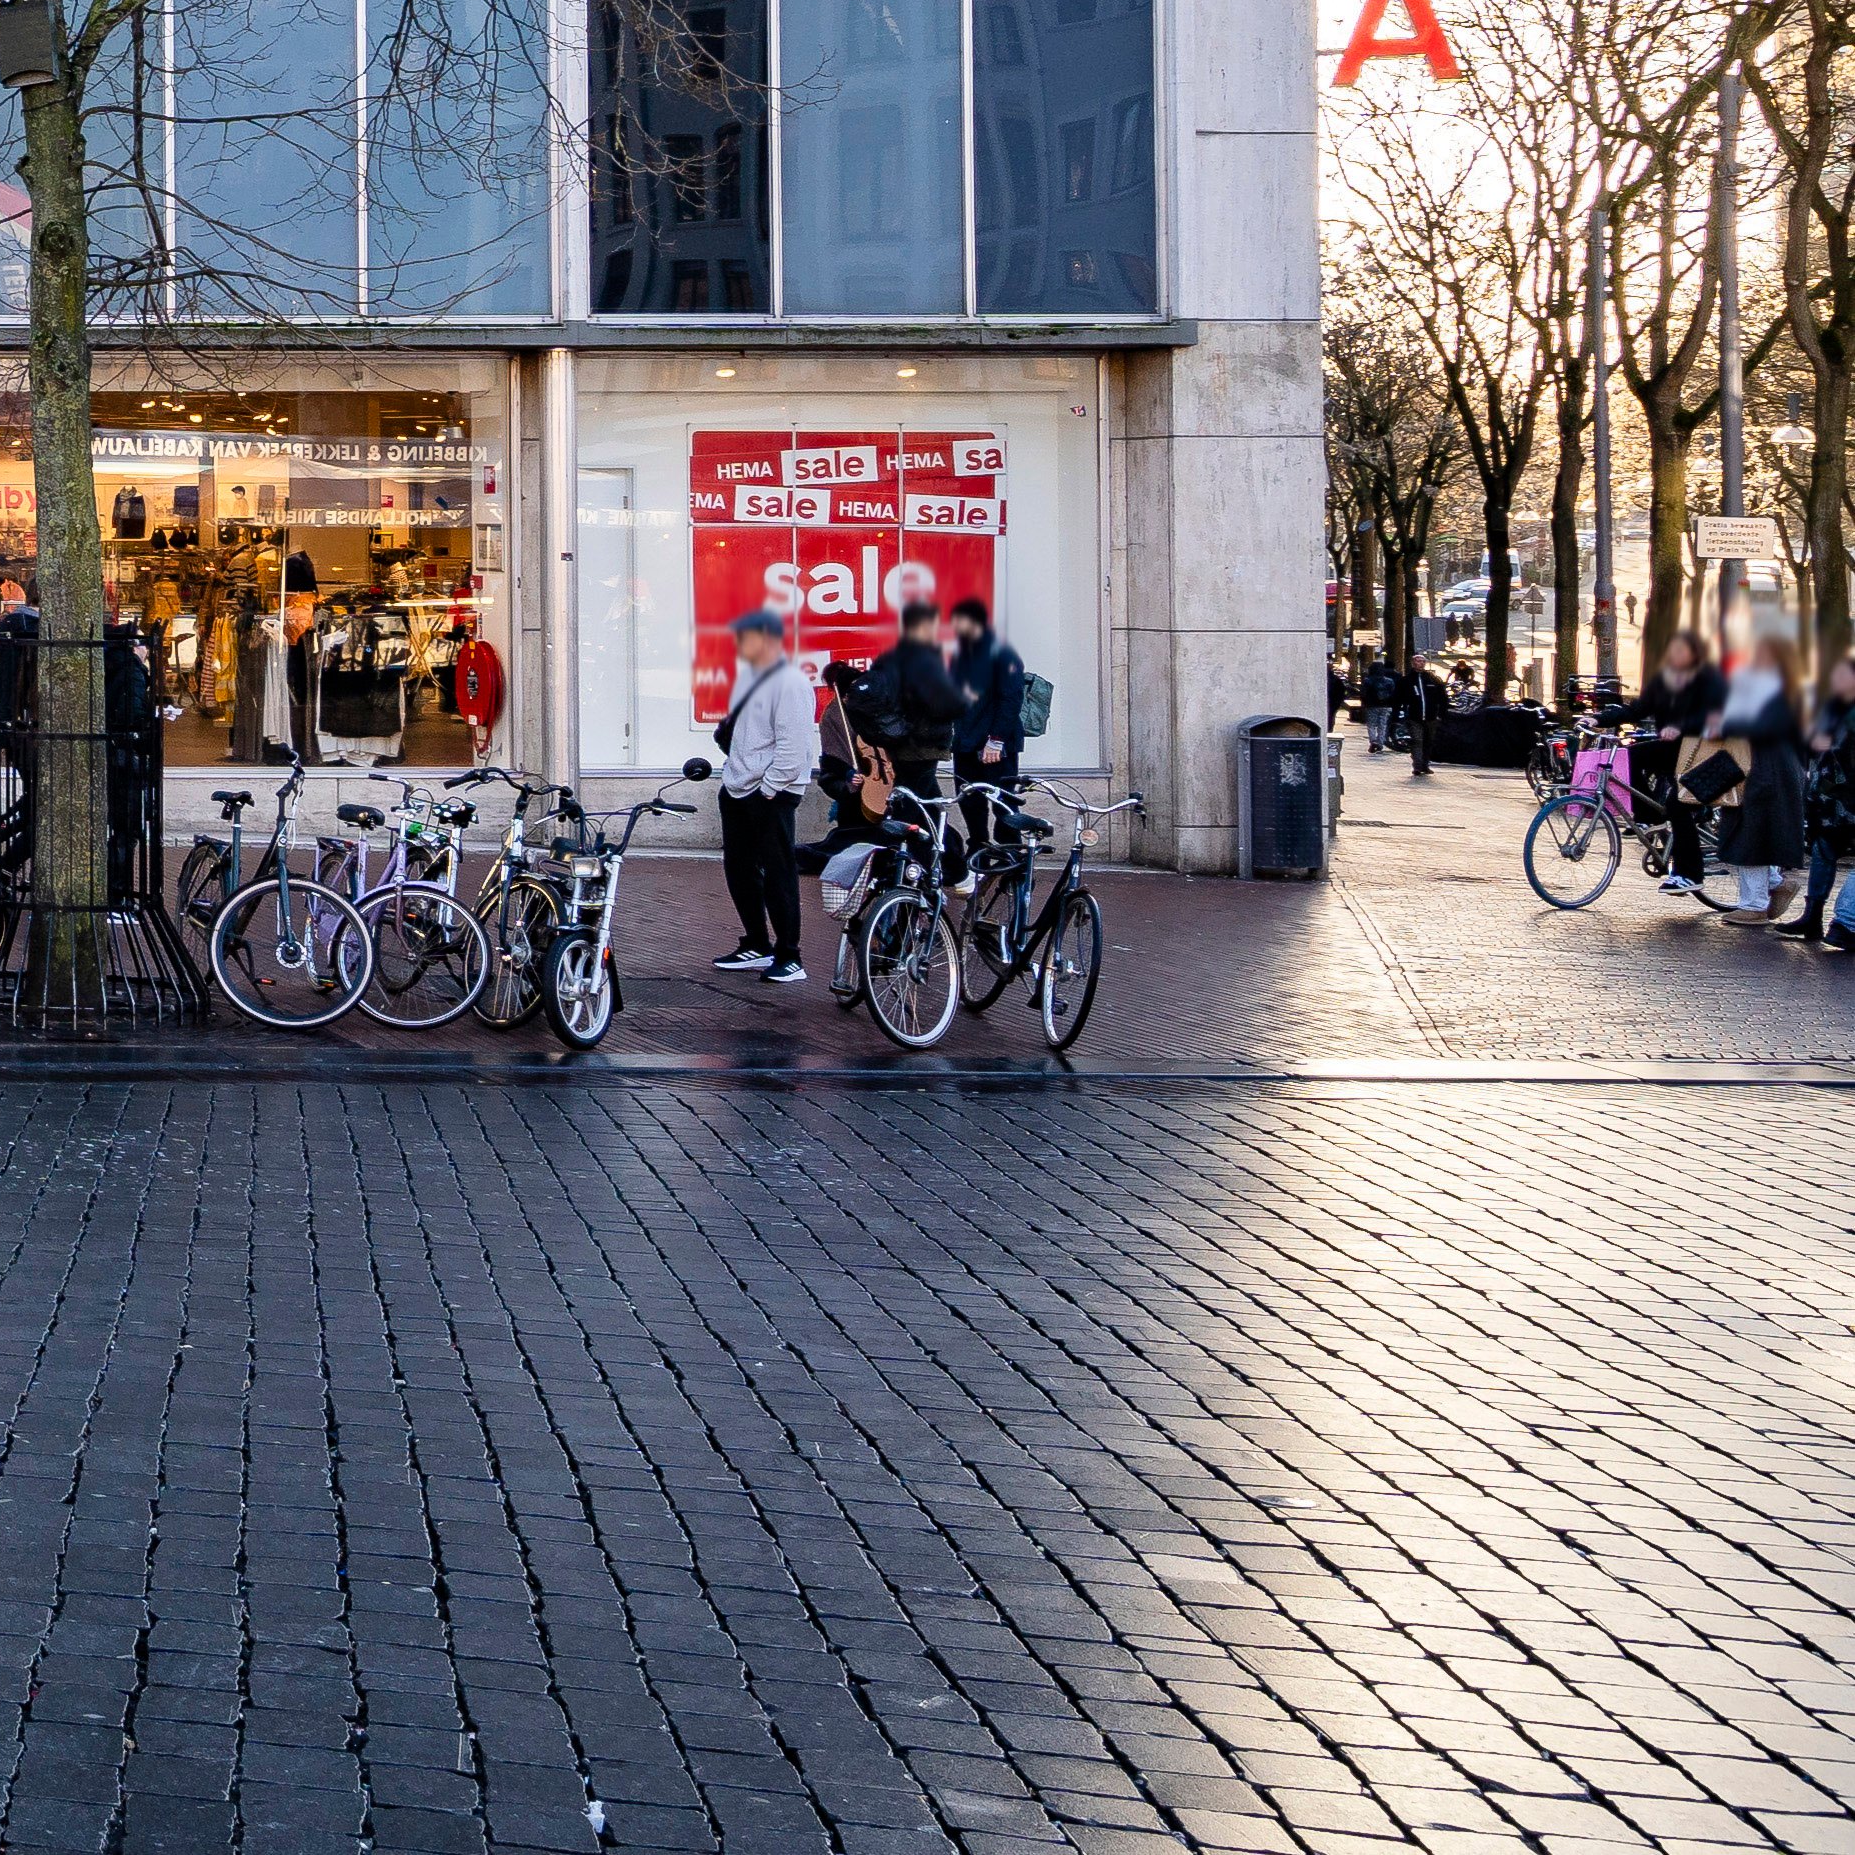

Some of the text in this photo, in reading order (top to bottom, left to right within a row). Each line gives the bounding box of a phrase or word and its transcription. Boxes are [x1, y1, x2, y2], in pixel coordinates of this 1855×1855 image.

[716, 447, 1005, 480] HEMA sale HEMA sa
[745, 490, 818, 519] sale
[838, 500, 895, 519] HEMA
[916, 499, 989, 526] sale
[762, 545, 936, 616] sale
